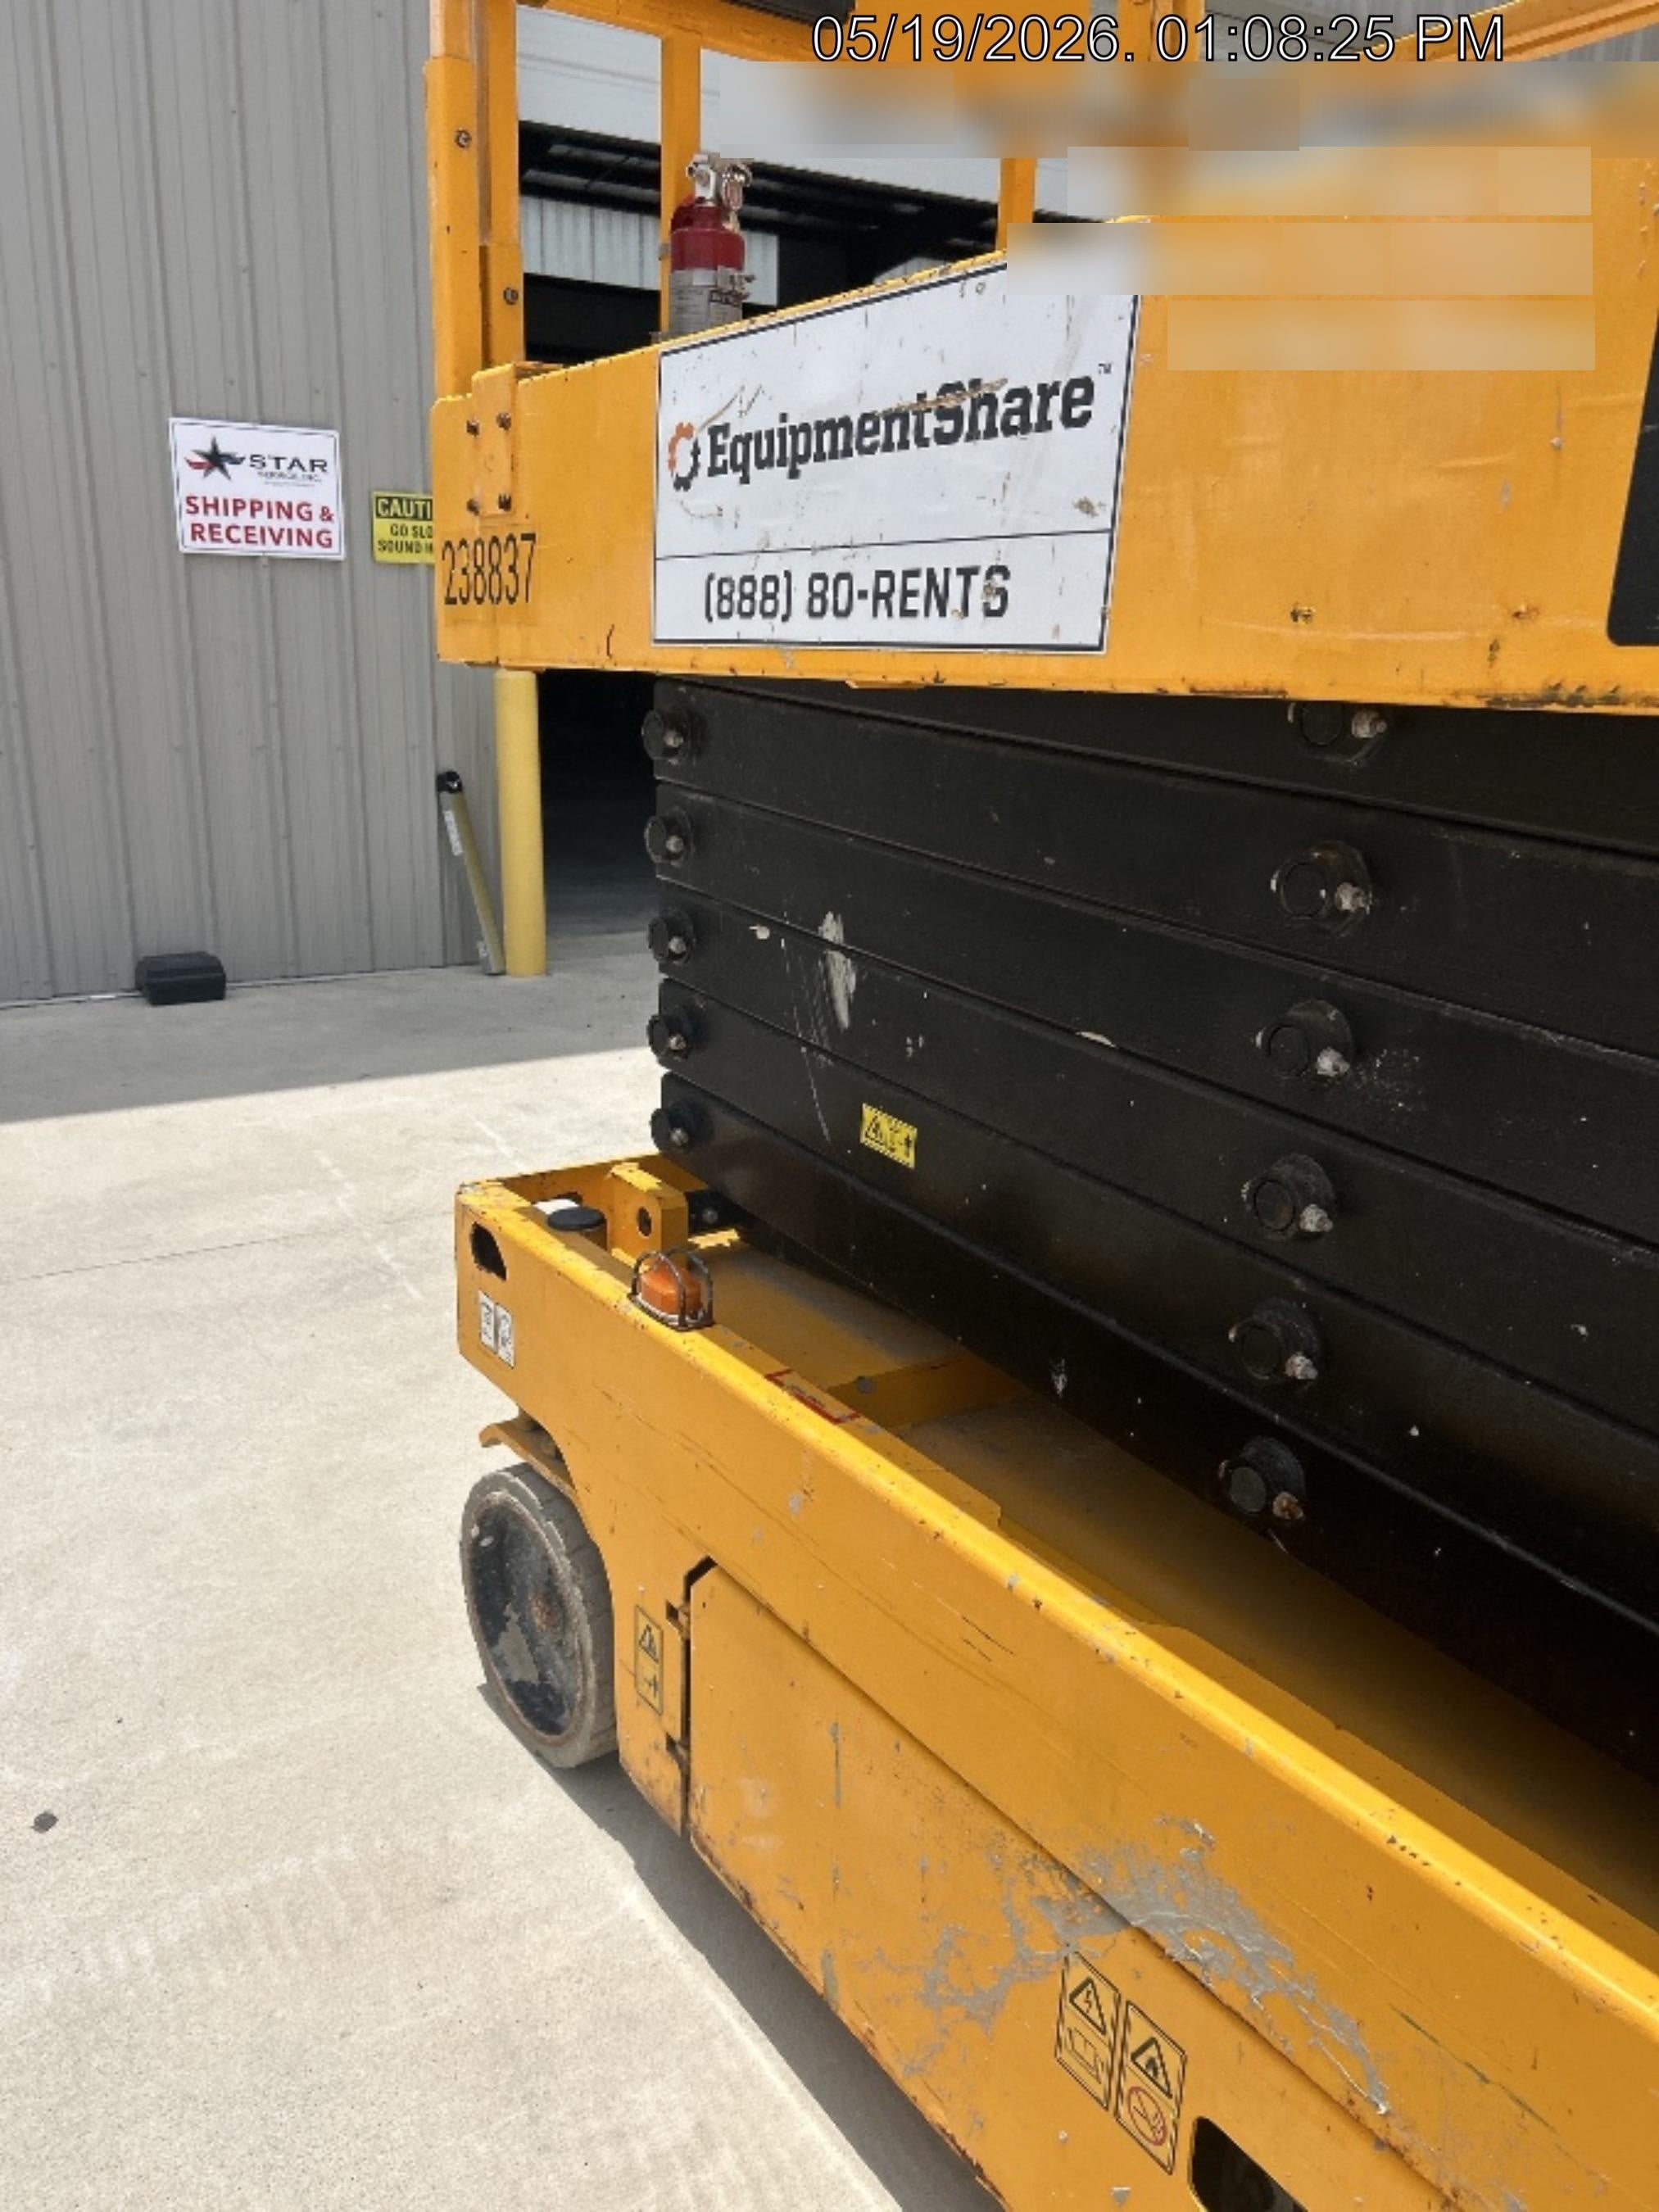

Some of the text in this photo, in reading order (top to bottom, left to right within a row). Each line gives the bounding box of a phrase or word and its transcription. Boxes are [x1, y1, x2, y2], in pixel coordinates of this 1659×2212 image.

[249, 455, 328, 473] STAR
[185, 496, 334, 522] SHIPPING &
[378, 498, 432, 519] CAUTI
[191, 523, 333, 548] RECEIVING
[412, 525, 433, 539] SLO
[378, 539, 422, 554] SOUND
[442, 533, 537, 605] 238837
[705, 565, 1012, 623] (888) 80-RENTS
